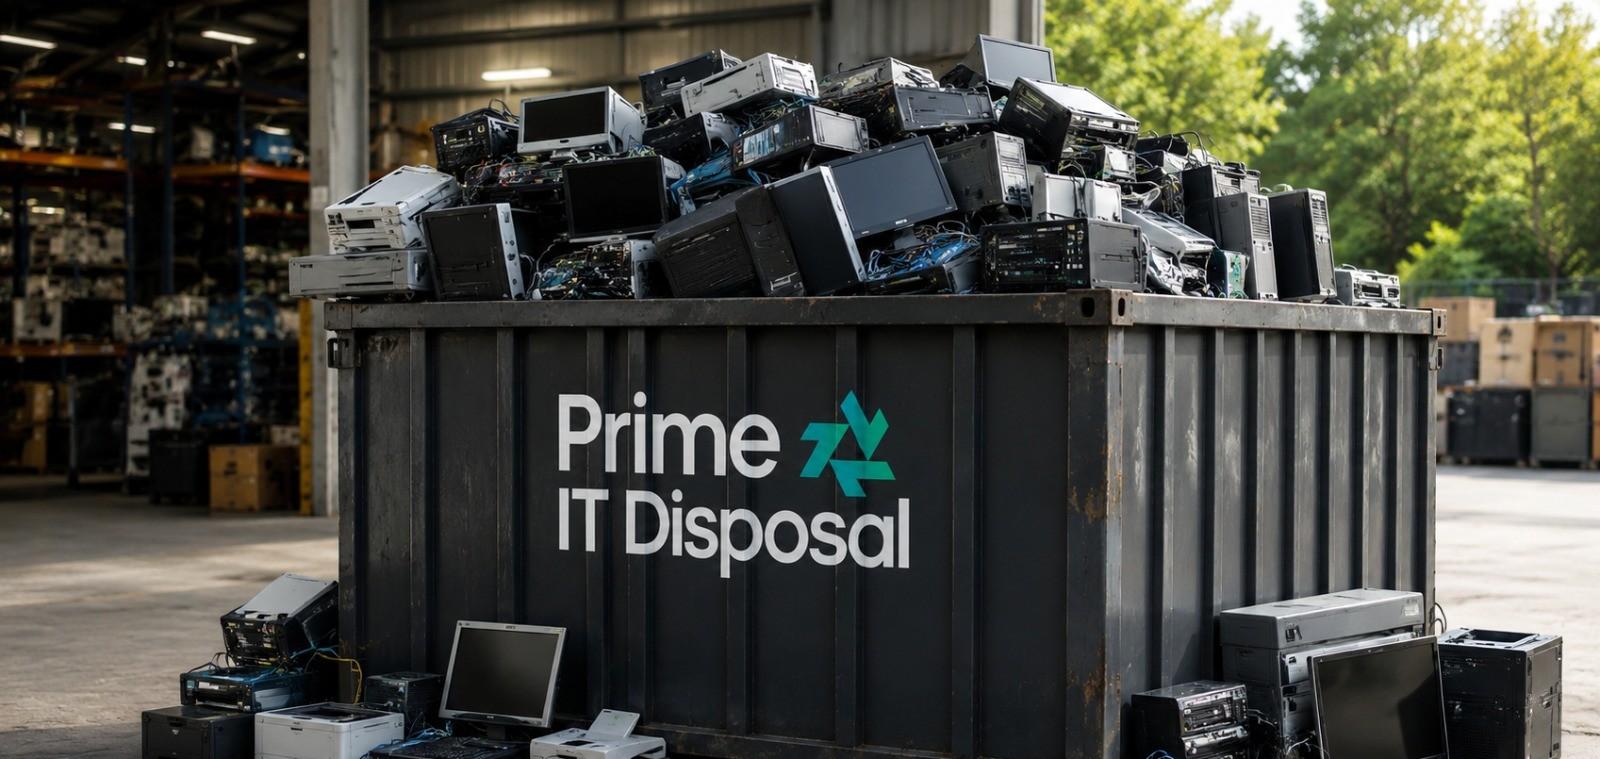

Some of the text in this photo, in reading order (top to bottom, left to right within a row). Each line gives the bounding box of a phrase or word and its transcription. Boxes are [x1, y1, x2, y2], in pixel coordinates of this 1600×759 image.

[558, 391, 781, 479] Prime
[558, 487, 910, 579] IT Disposal
